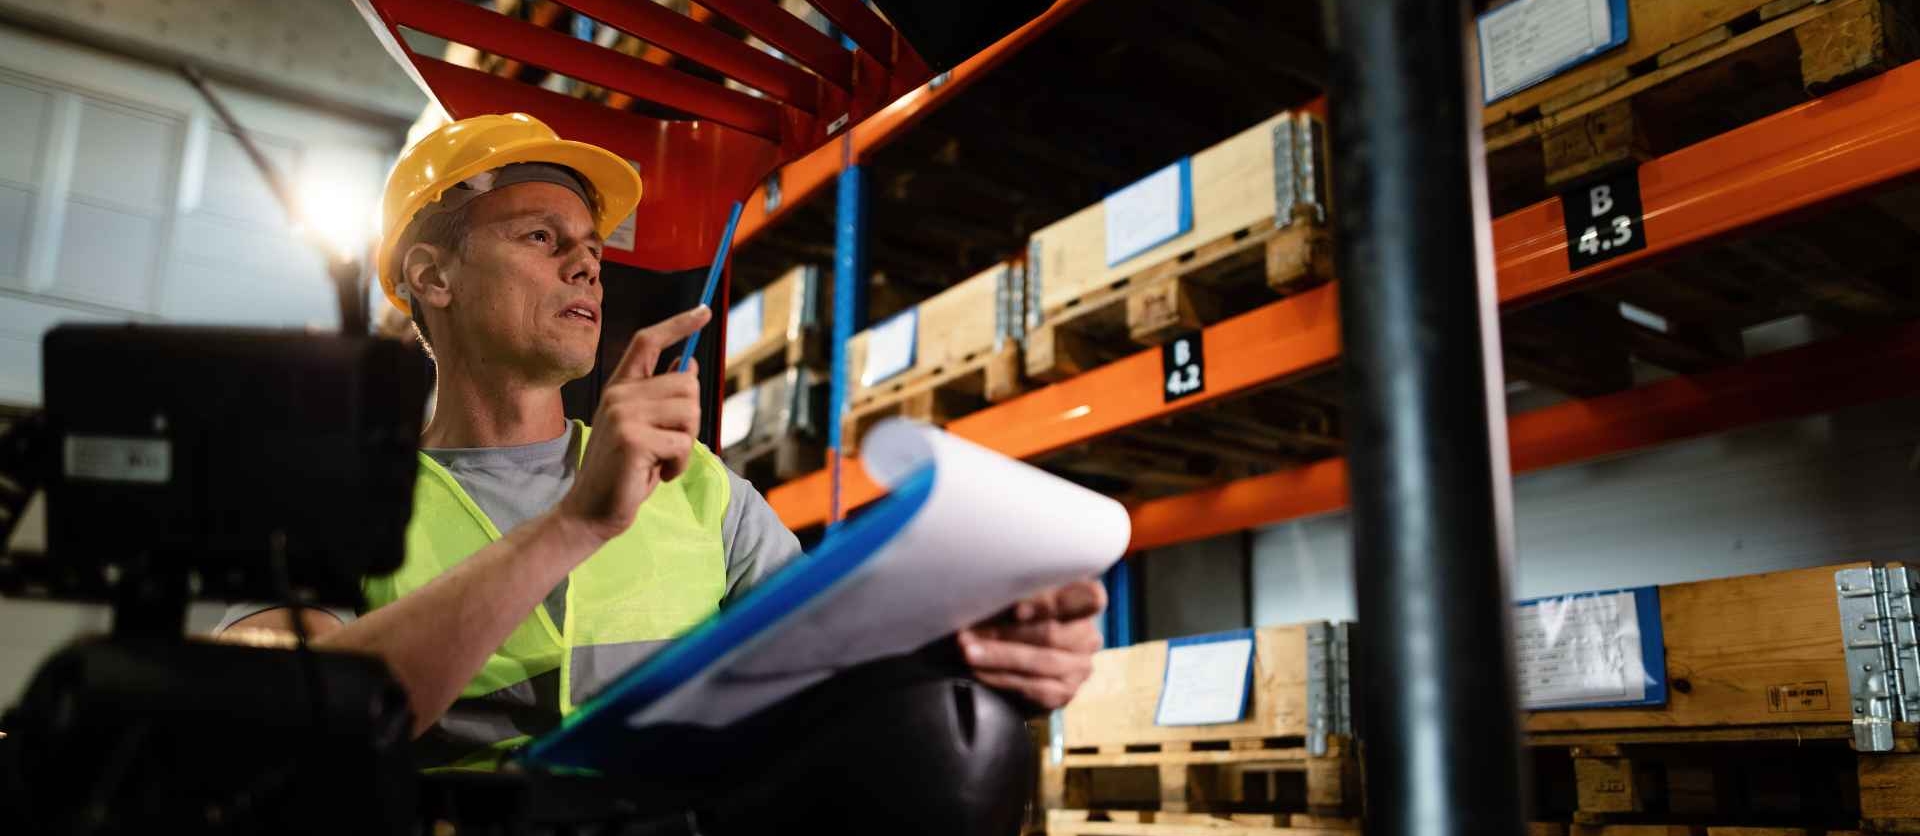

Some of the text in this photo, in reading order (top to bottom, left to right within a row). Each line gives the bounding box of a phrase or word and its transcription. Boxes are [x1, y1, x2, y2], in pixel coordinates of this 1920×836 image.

[1590, 184, 1614, 218] B
[1578, 215, 1632, 255] 4.3
[1174, 339, 1191, 367] B
[1167, 364, 1201, 395] 4.2
